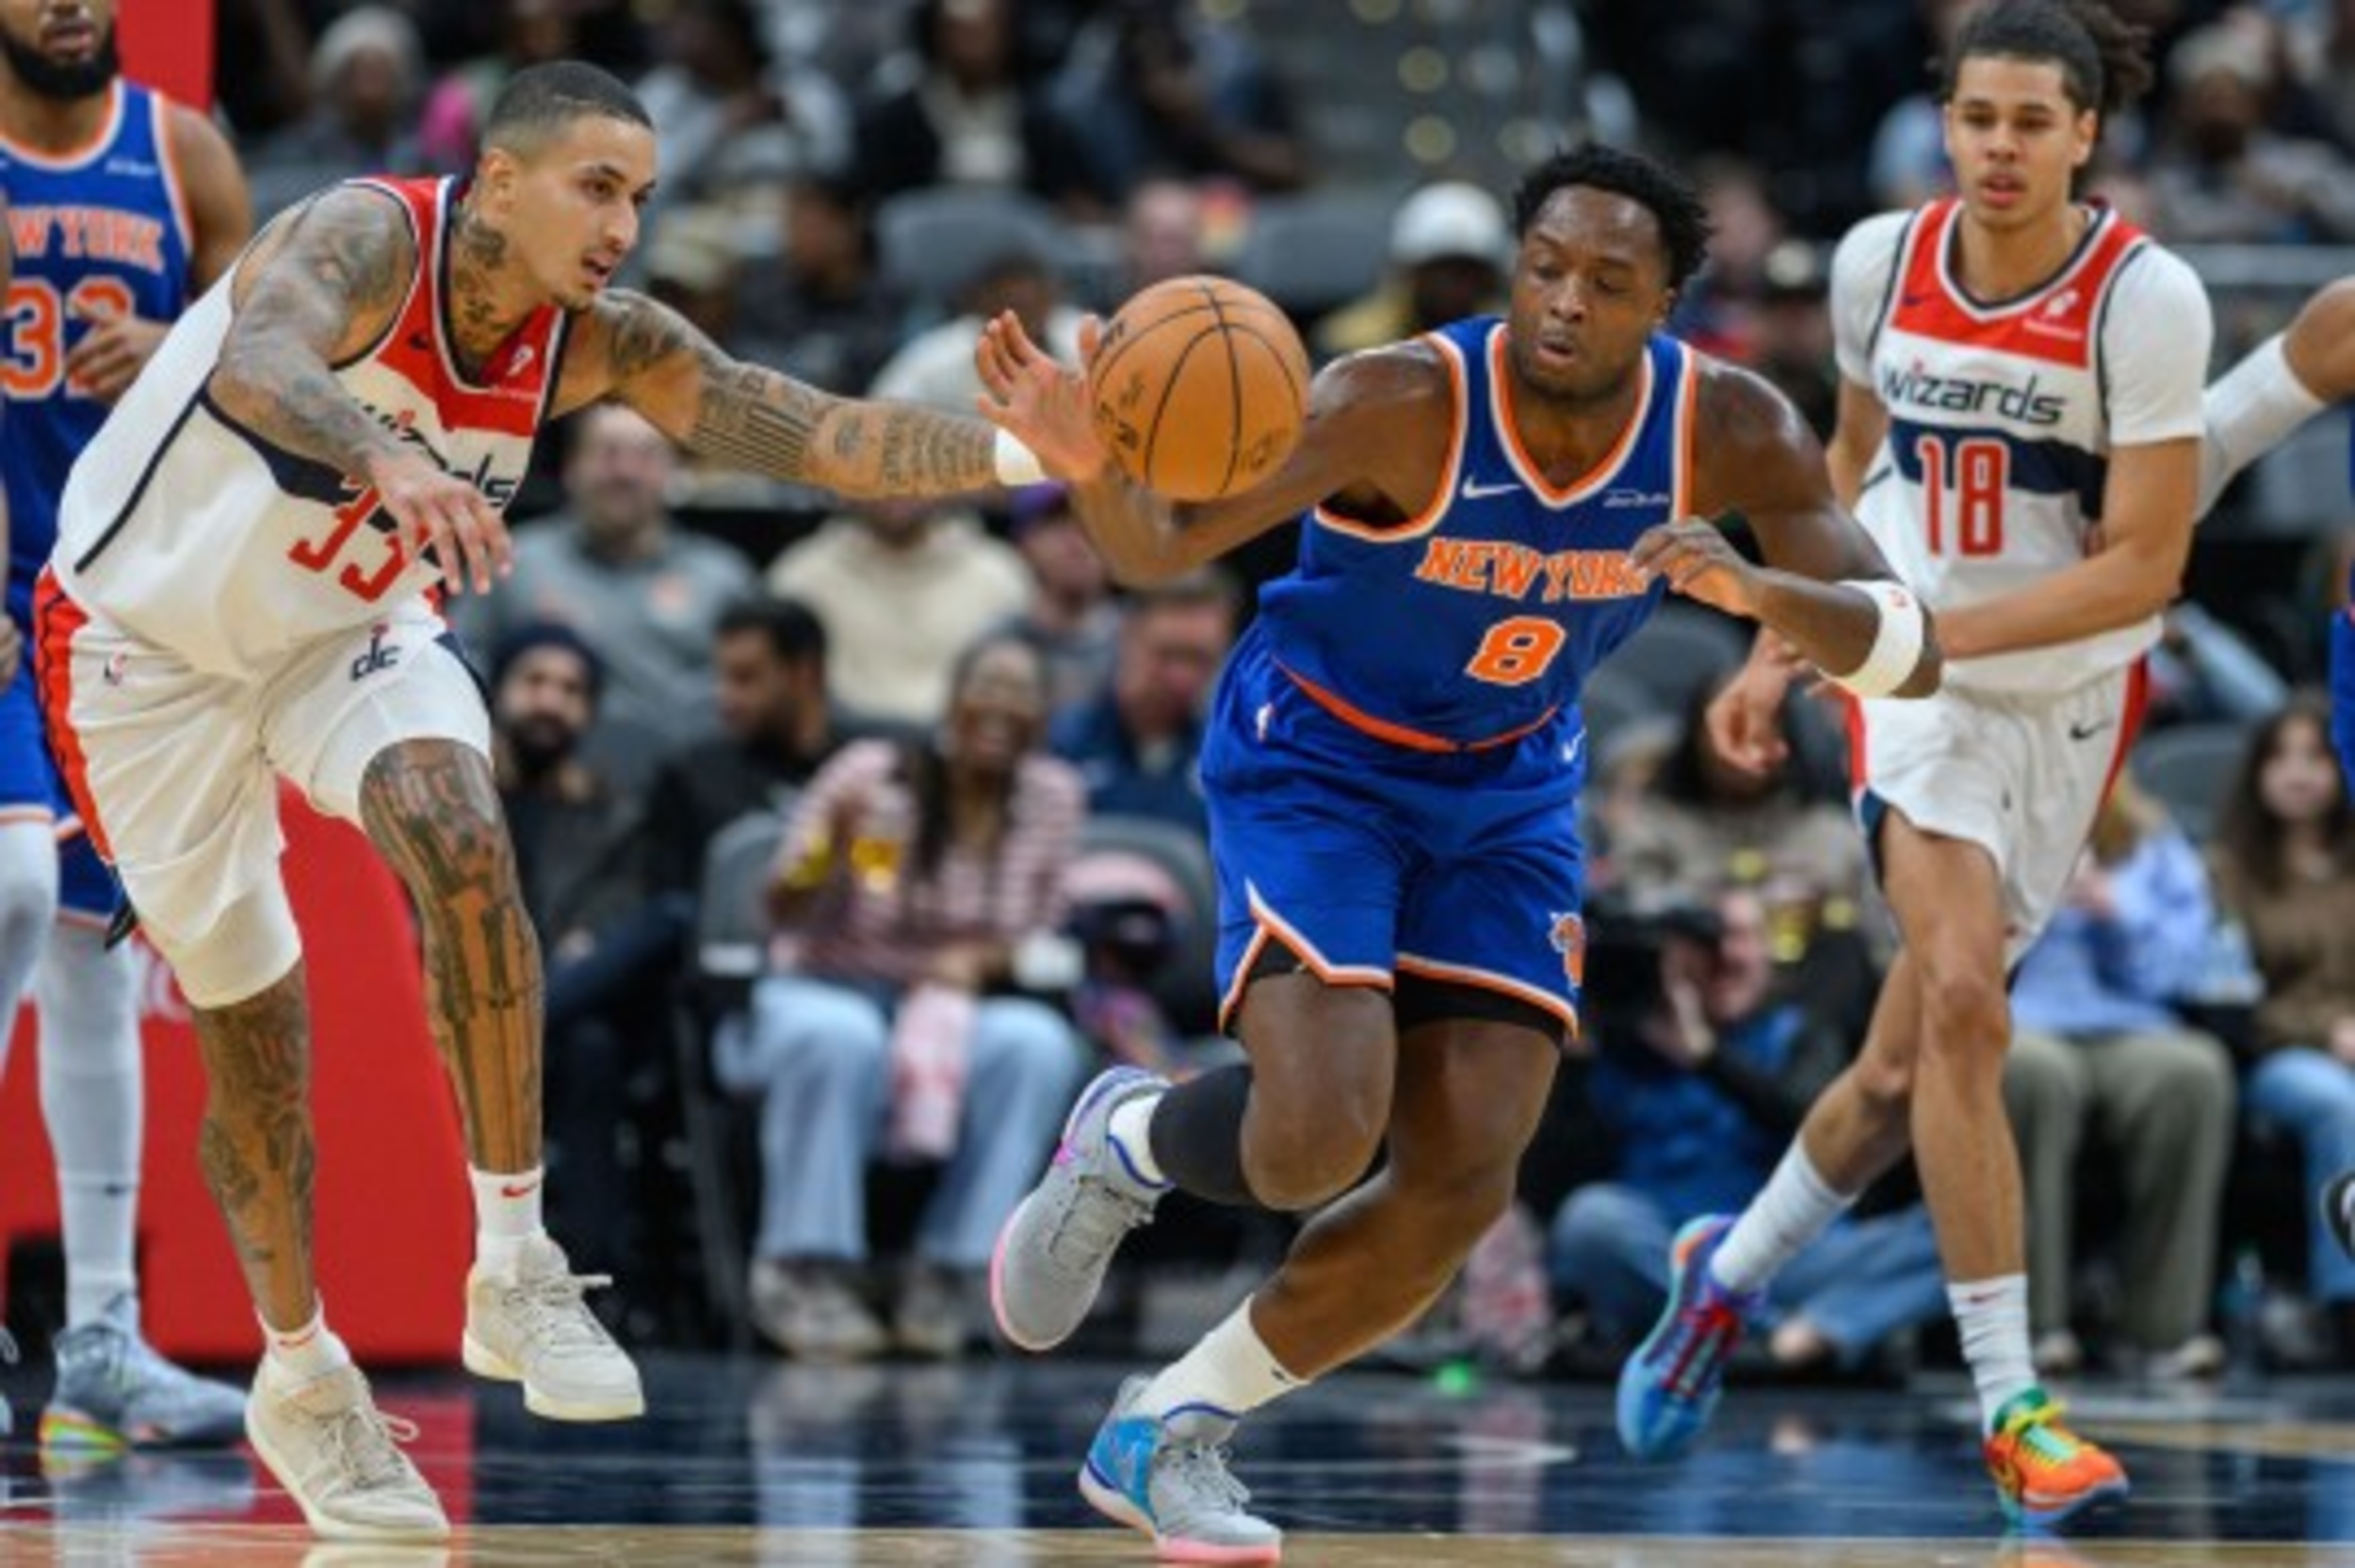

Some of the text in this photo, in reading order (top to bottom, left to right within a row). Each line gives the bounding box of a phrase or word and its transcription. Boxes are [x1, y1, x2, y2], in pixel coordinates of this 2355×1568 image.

[1916, 436, 2010, 558] 18
[1413, 537, 1544, 601] NEW
[1464, 615, 1567, 687] 8
